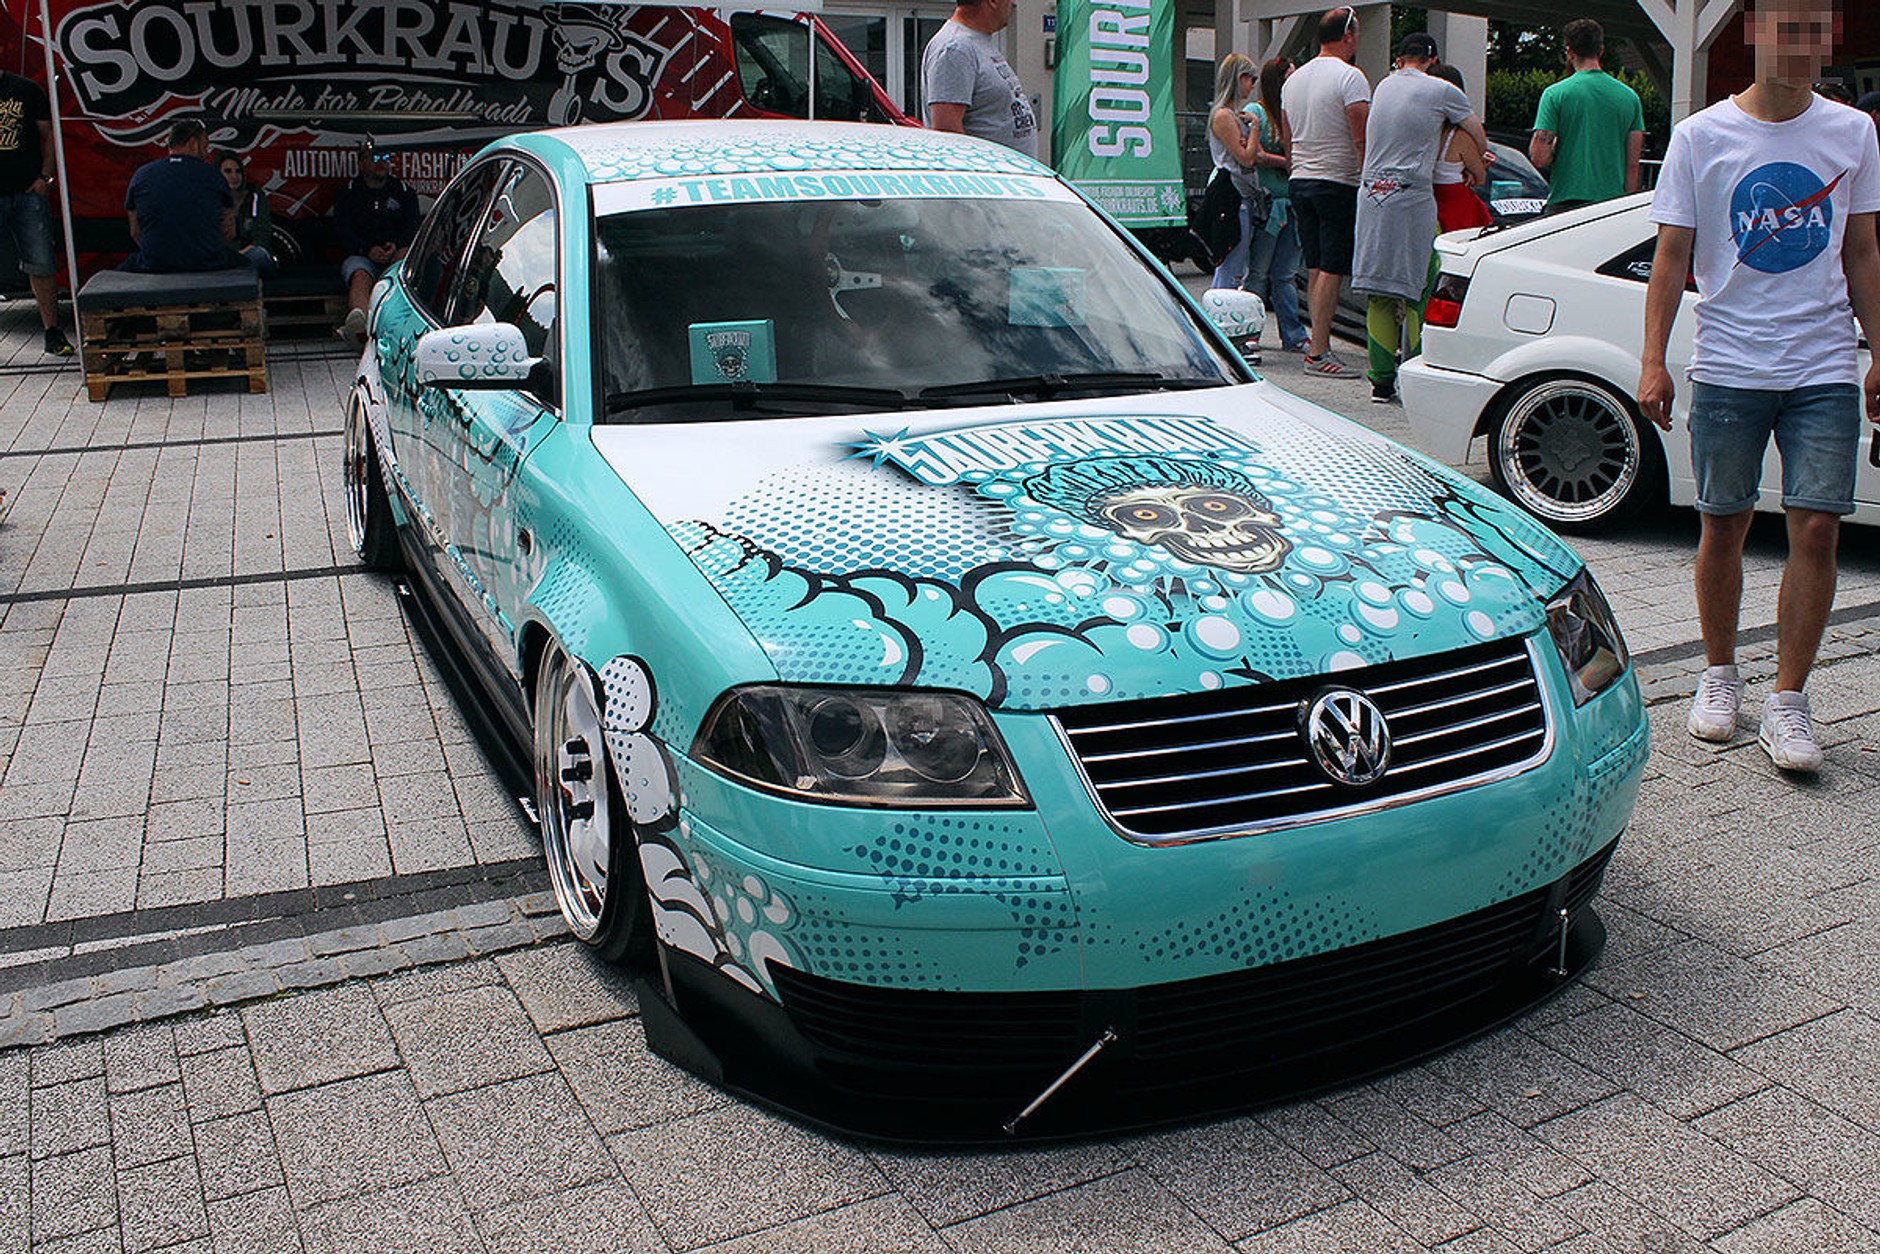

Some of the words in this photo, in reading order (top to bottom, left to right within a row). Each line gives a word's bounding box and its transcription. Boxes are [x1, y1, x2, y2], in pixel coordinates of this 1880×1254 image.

[1088, 0, 1152, 158] SOUR
[210, 85, 305, 120] Made
[312, 84, 360, 124] for
[367, 85, 534, 124] Petrolheads
[285, 149, 398, 178] AUTOMOE
[651, 175, 1046, 204] #TEAMSOURKRAUTS
[1737, 205, 1826, 232] NASA
[1309, 691, 1391, 785] VW
